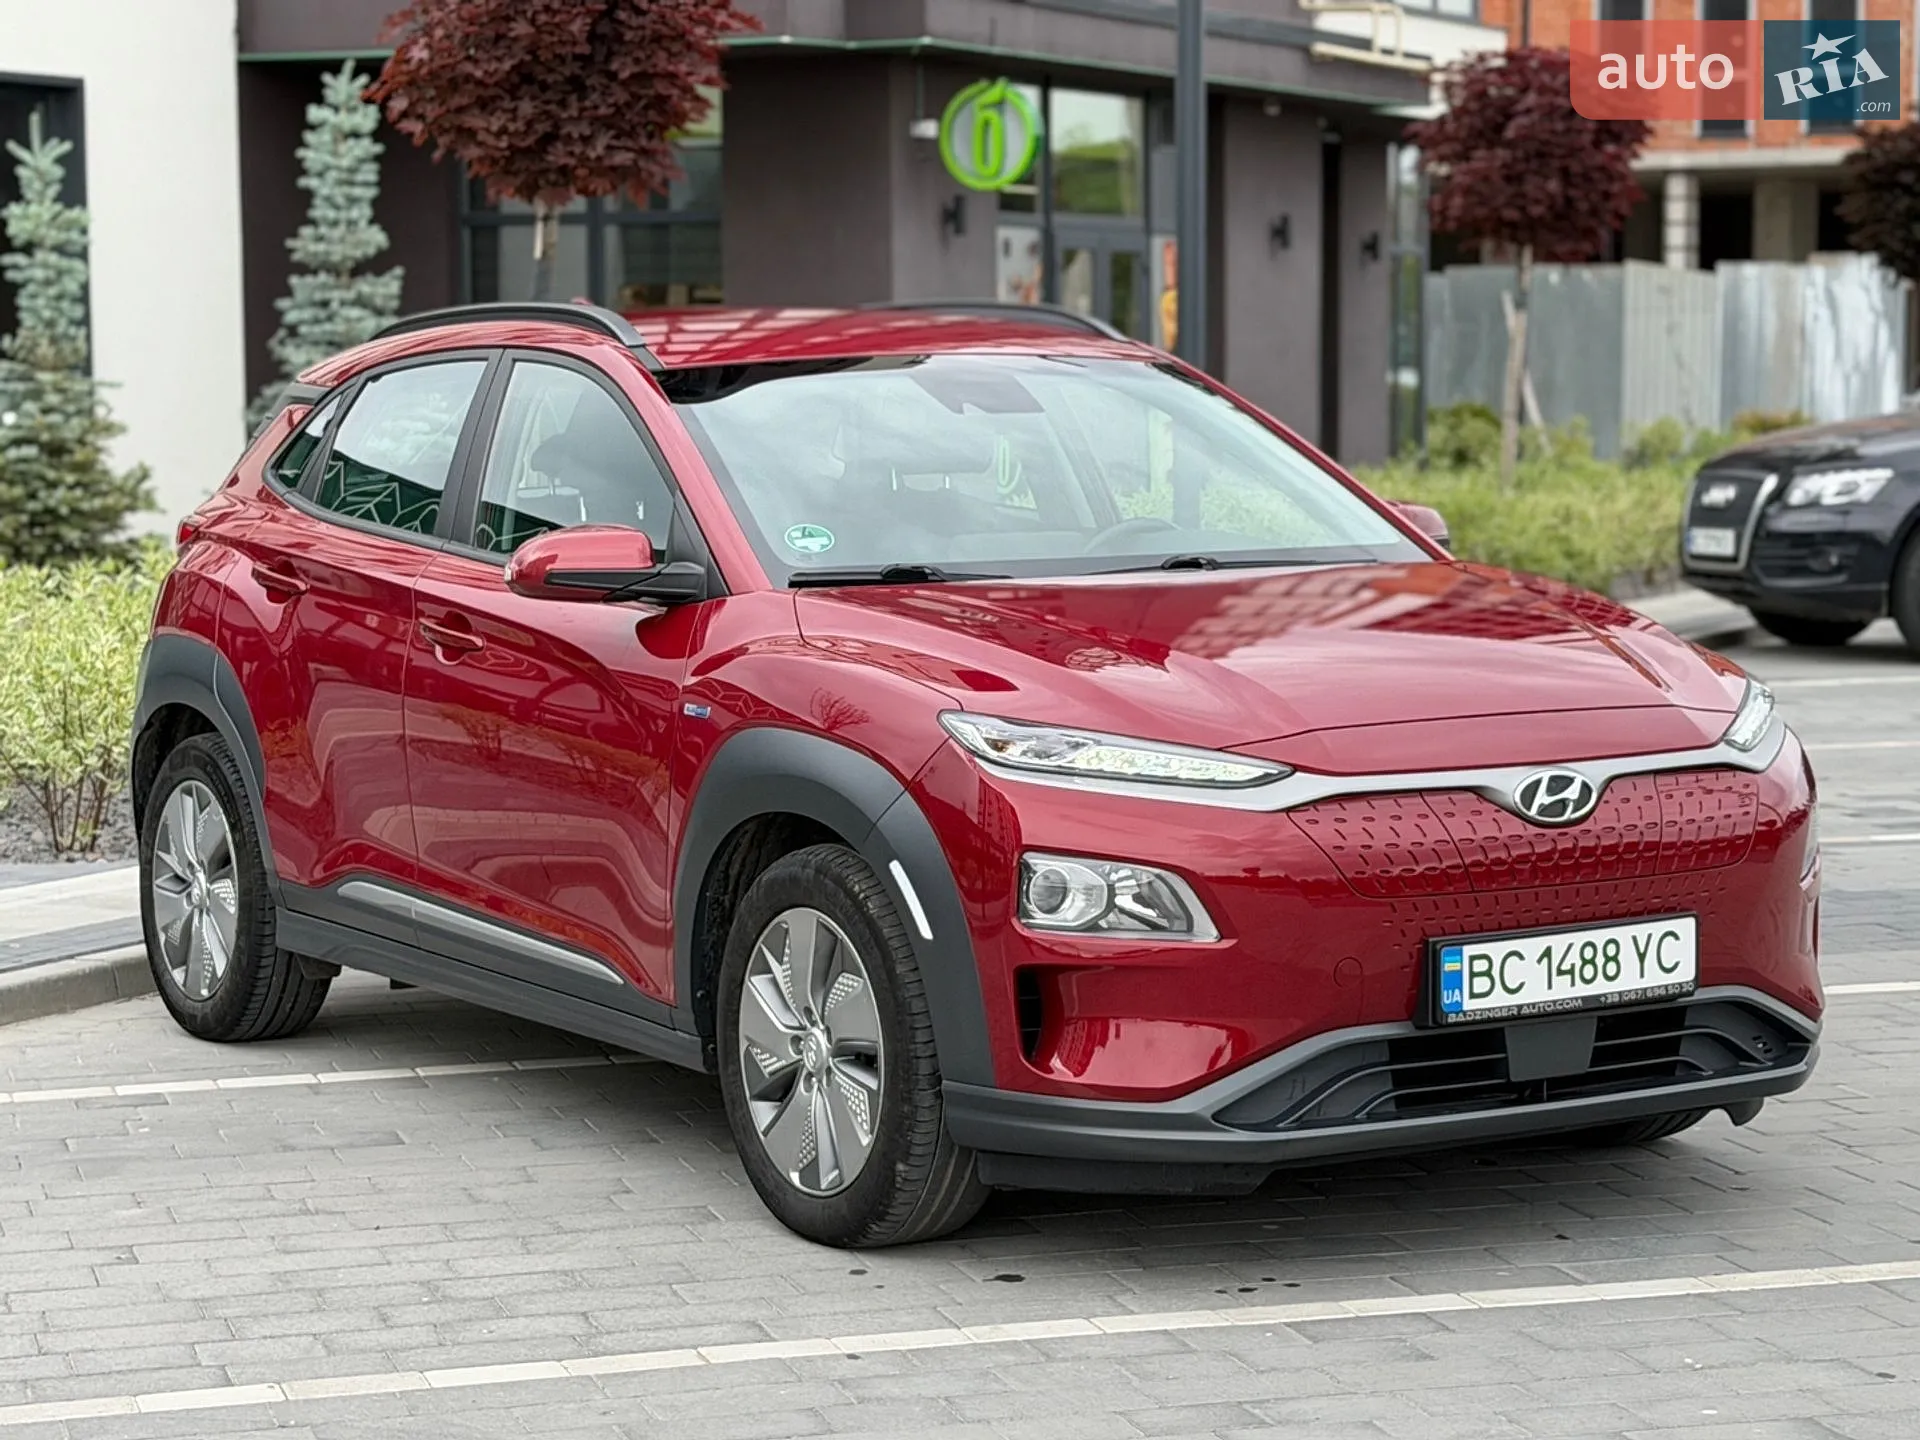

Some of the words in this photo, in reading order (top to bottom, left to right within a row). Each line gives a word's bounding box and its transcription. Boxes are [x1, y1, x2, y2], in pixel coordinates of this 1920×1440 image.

[1468, 949, 1526, 1000] BC
[1536, 937, 1622, 991] 1488
[1631, 929, 1681, 979] YC
[1443, 988, 1462, 1005] UA
